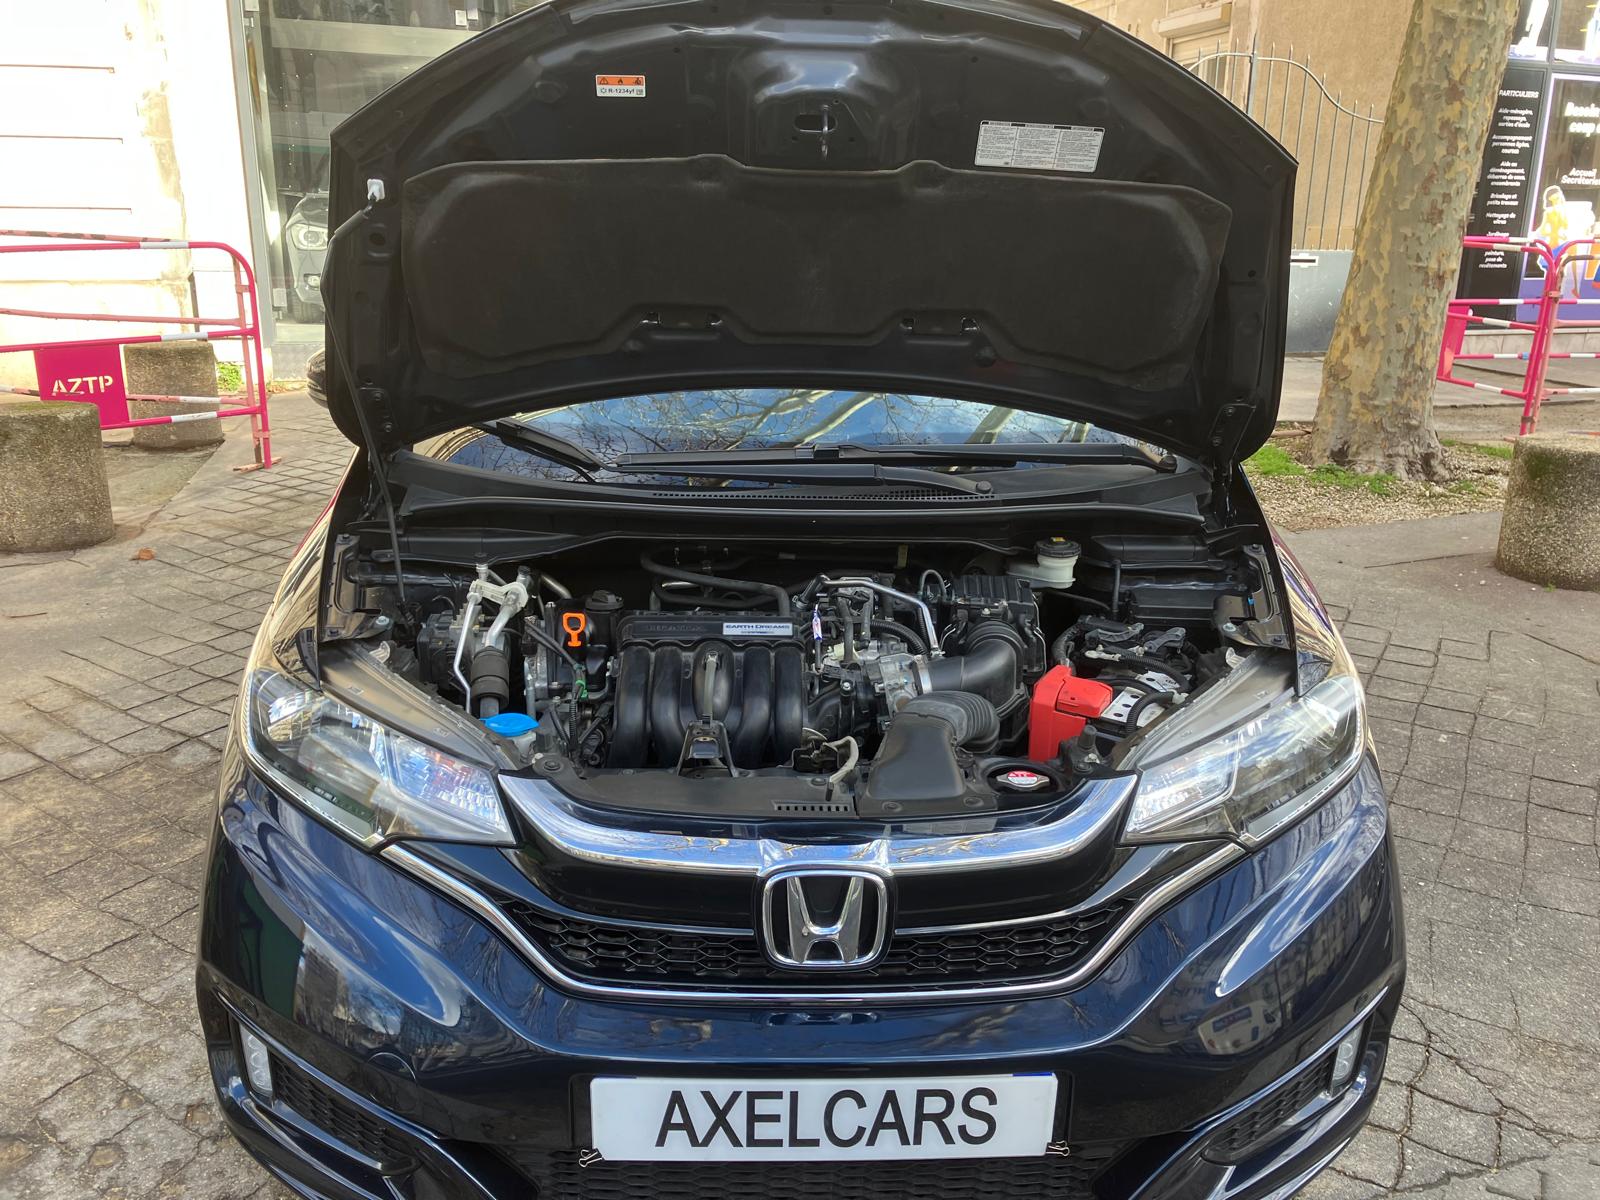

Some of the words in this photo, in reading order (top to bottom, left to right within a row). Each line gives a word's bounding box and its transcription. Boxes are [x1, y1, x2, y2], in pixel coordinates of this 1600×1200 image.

[1499, 90, 1539, 98] PARTICULIERS
[1569, 121, 1595, 137] coup
[52, 375, 114, 396] AZTP
[655, 1087, 998, 1148] AXELCARS
